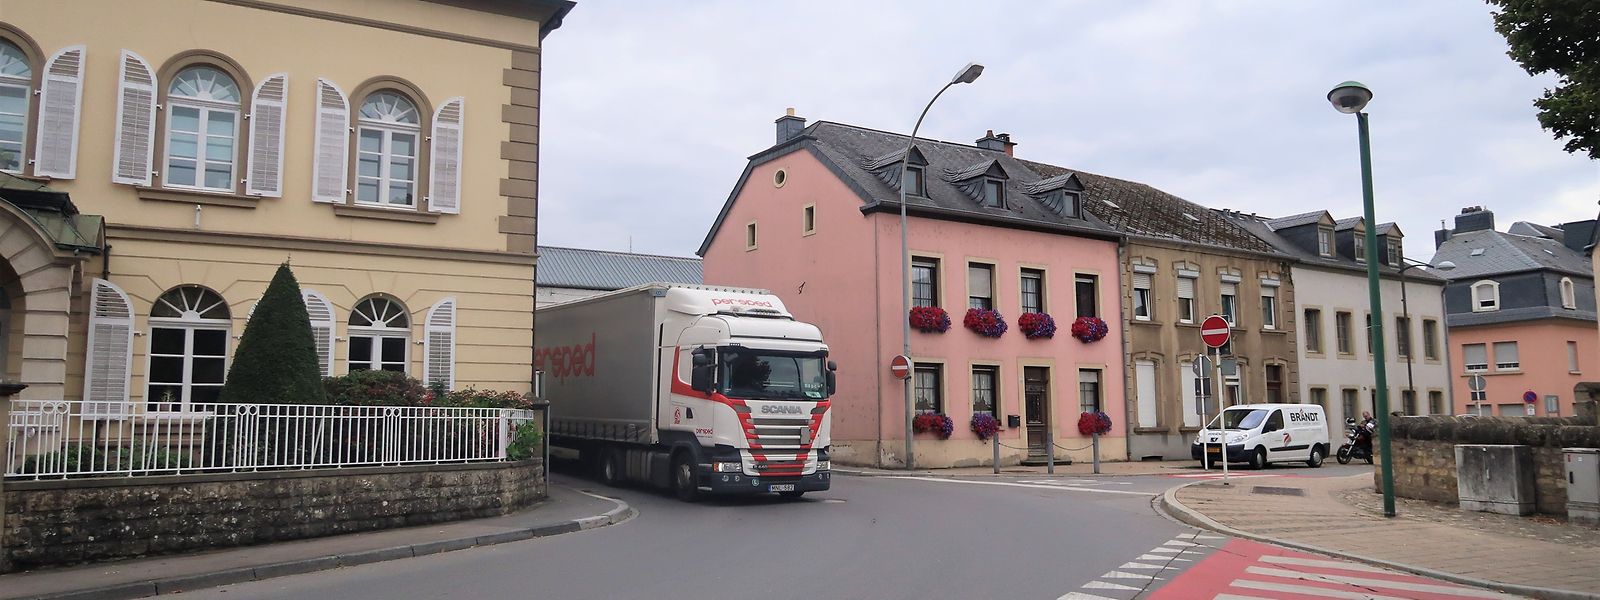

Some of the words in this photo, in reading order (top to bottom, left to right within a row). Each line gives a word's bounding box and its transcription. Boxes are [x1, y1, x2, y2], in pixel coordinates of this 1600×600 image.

[534, 332, 595, 385] ersped
[761, 405, 802, 415] SCANIA
[1290, 412, 1318, 422] BRANDT
